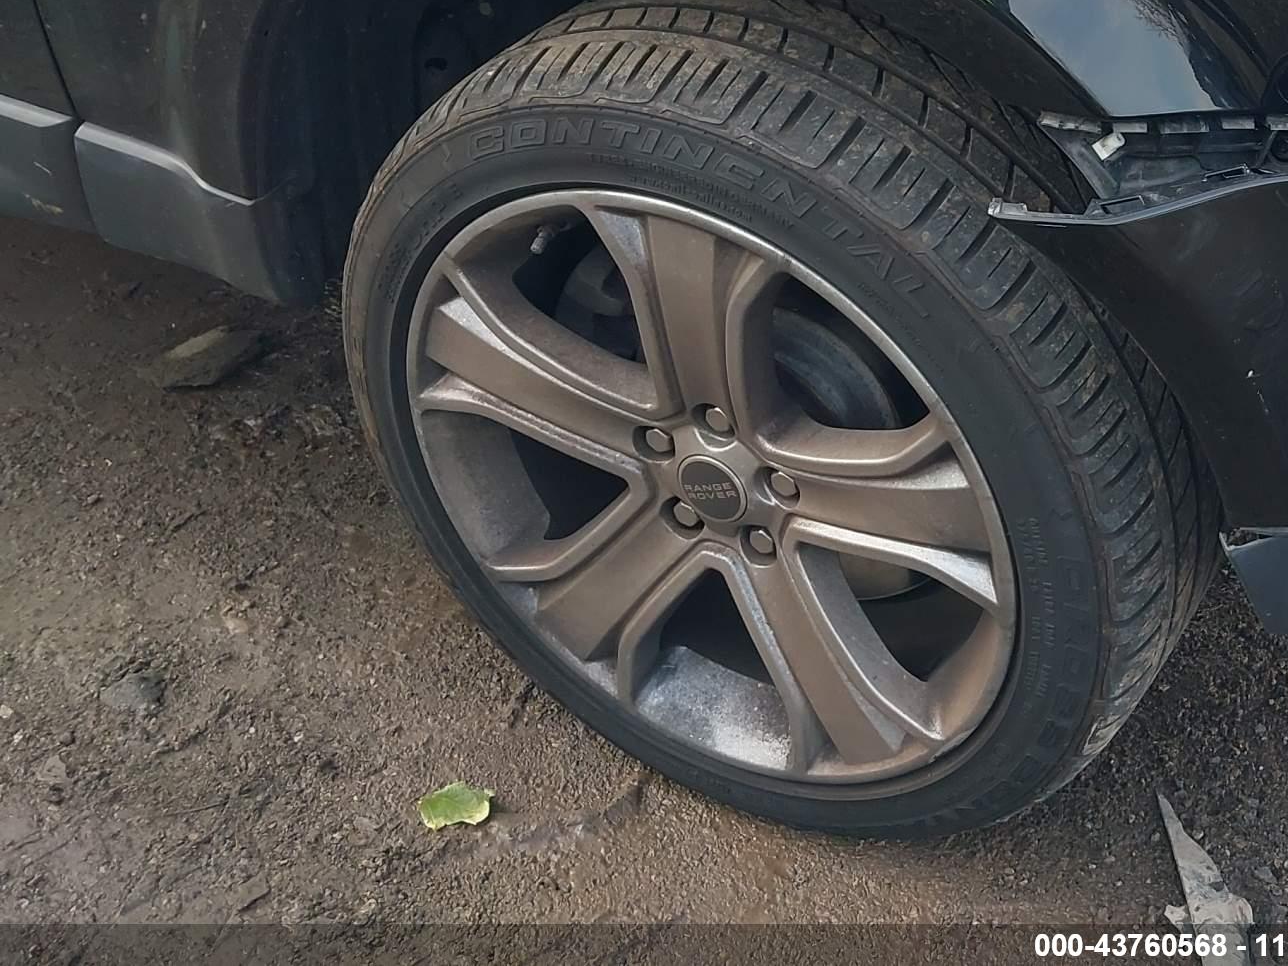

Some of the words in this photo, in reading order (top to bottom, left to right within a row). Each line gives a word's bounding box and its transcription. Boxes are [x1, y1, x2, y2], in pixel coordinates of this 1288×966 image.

[467, 115, 933, 320] CONTINENTAL
[683, 482, 732, 492] RANGE
[687, 491, 737, 500] ROVER
